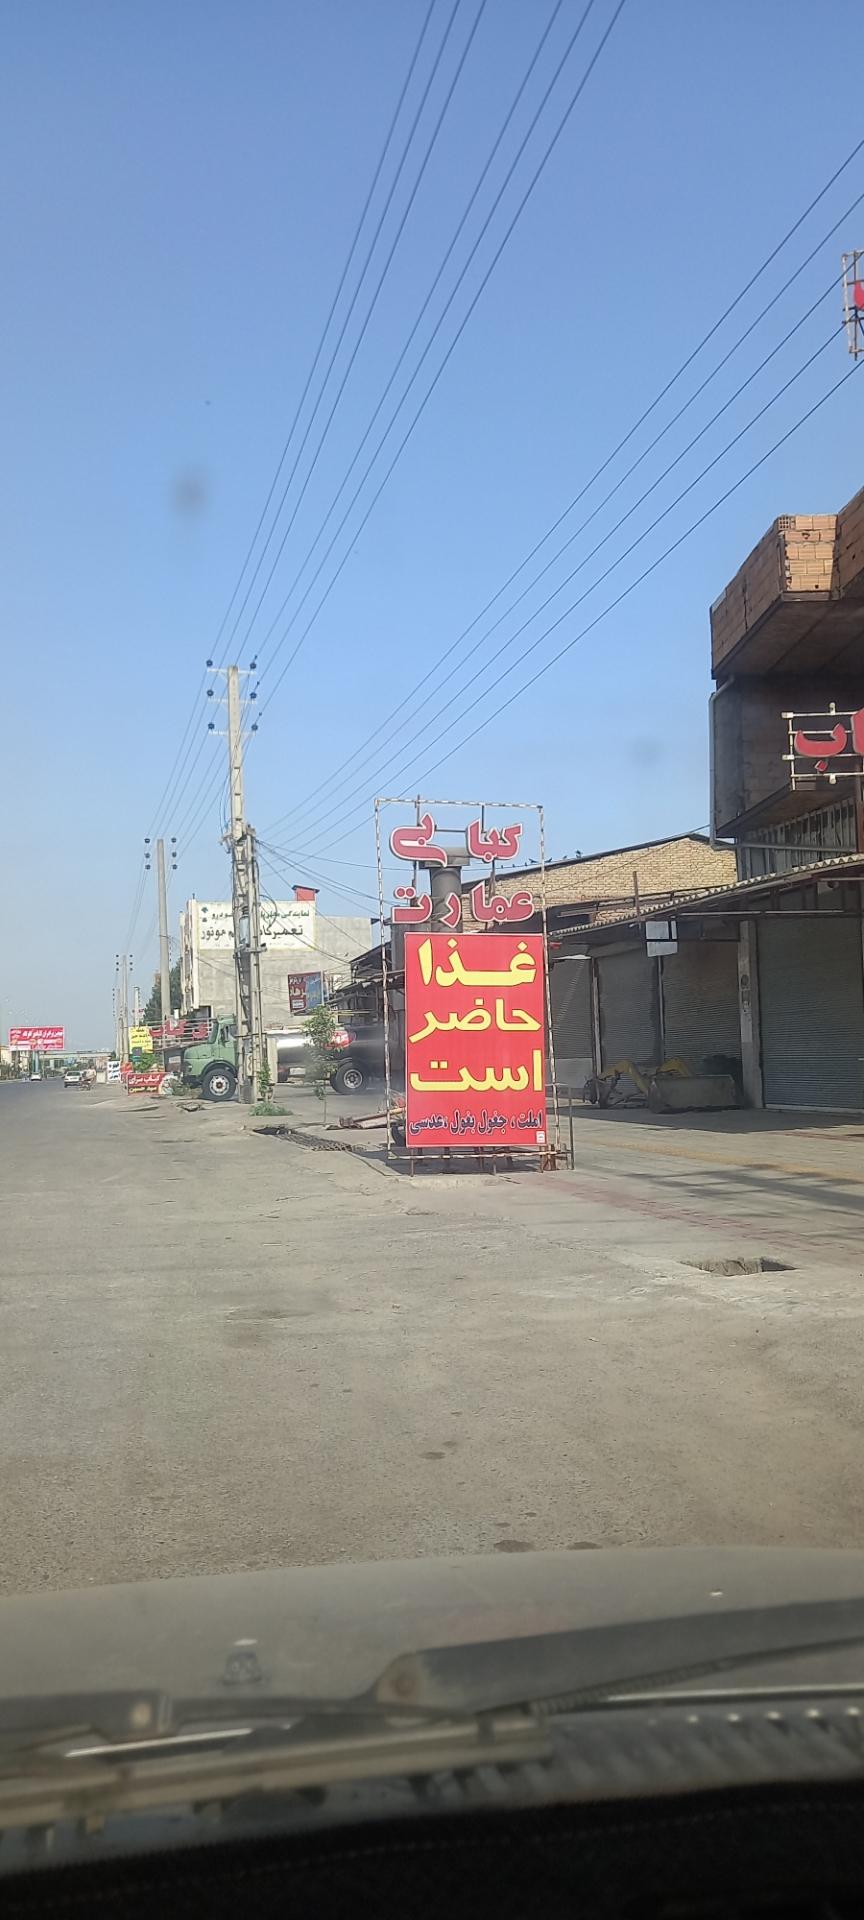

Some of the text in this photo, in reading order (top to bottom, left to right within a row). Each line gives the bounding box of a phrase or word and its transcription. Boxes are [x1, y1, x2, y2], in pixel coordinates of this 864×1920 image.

[390, 812, 523, 867] کبابی
[391, 880, 536, 929] عمارت
[200, 926, 227, 941] موتور
[417, 936, 537, 988] غذا
[408, 996, 542, 1043] حاضر
[408, 1048, 543, 1093] است
[449, 1109, 476, 1135] بغول
[477, 1109, 508, 1135] جغول
[516, 1108, 544, 1130] املت
